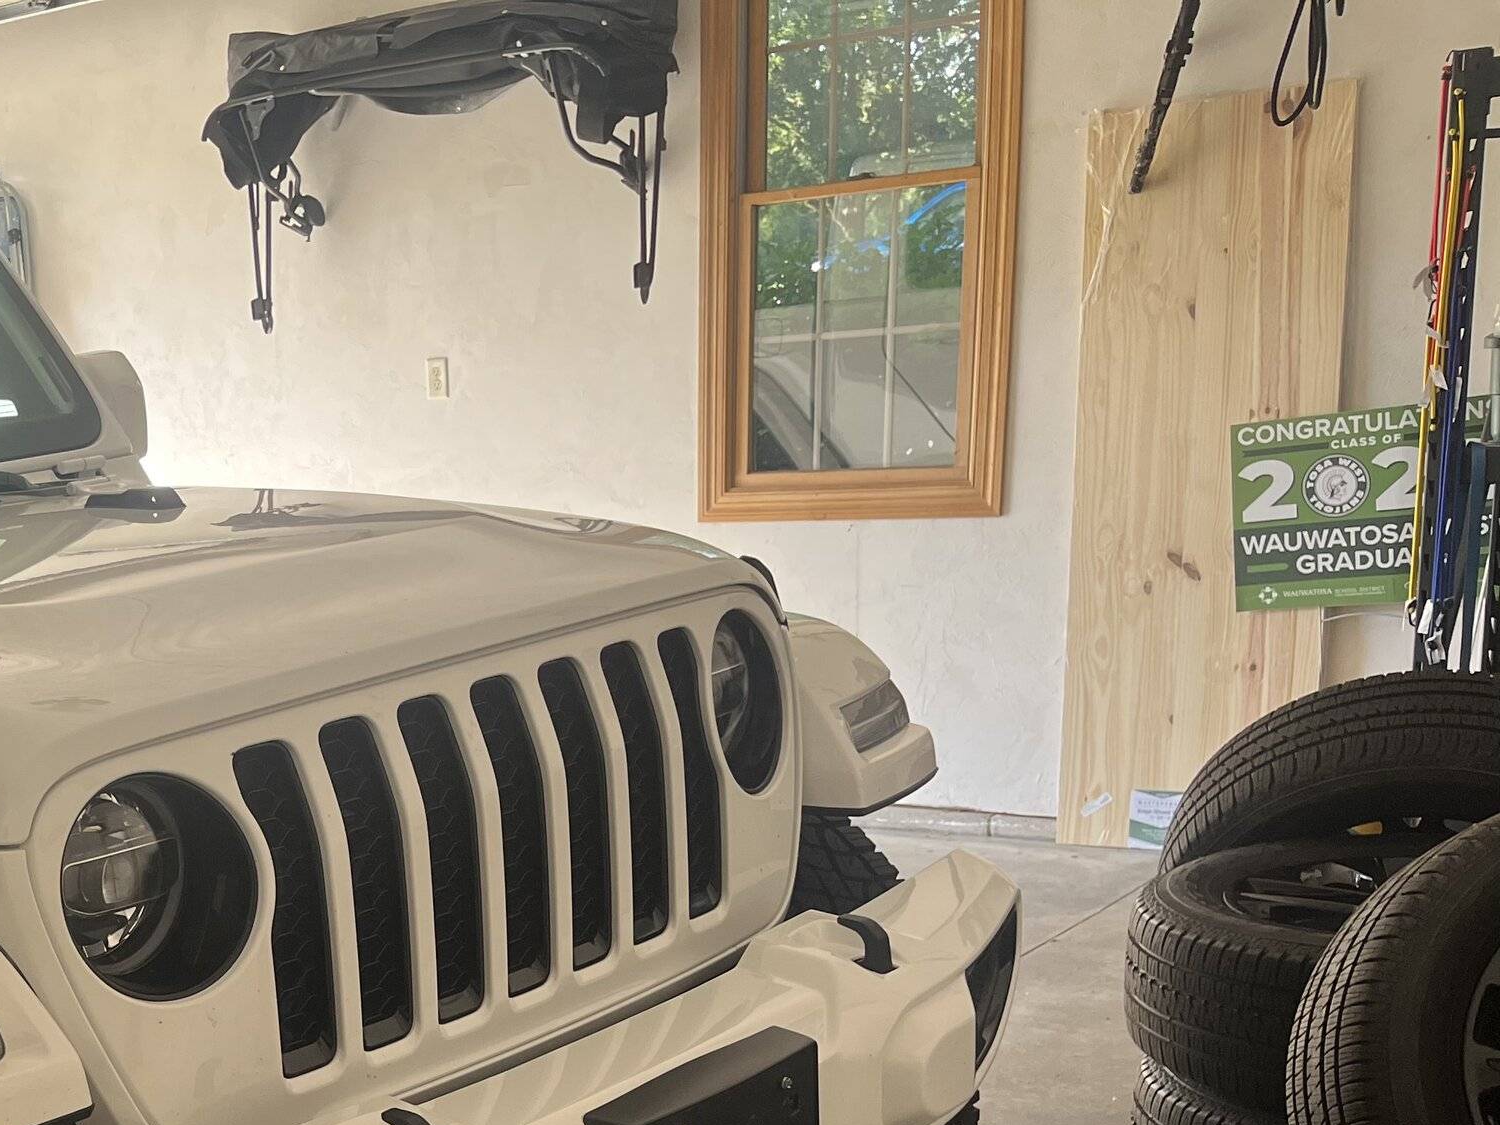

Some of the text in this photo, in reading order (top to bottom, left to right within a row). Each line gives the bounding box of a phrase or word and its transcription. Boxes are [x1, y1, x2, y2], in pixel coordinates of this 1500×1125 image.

[1331, 433, 1402, 450] CLASS OF
[1306, 457, 1366, 489] TOSA WEST
[1309, 489, 1364, 514] TROJANS
[1240, 522, 1415, 556] WAUWATOSA
[1296, 547, 1412, 575] GRADUA
